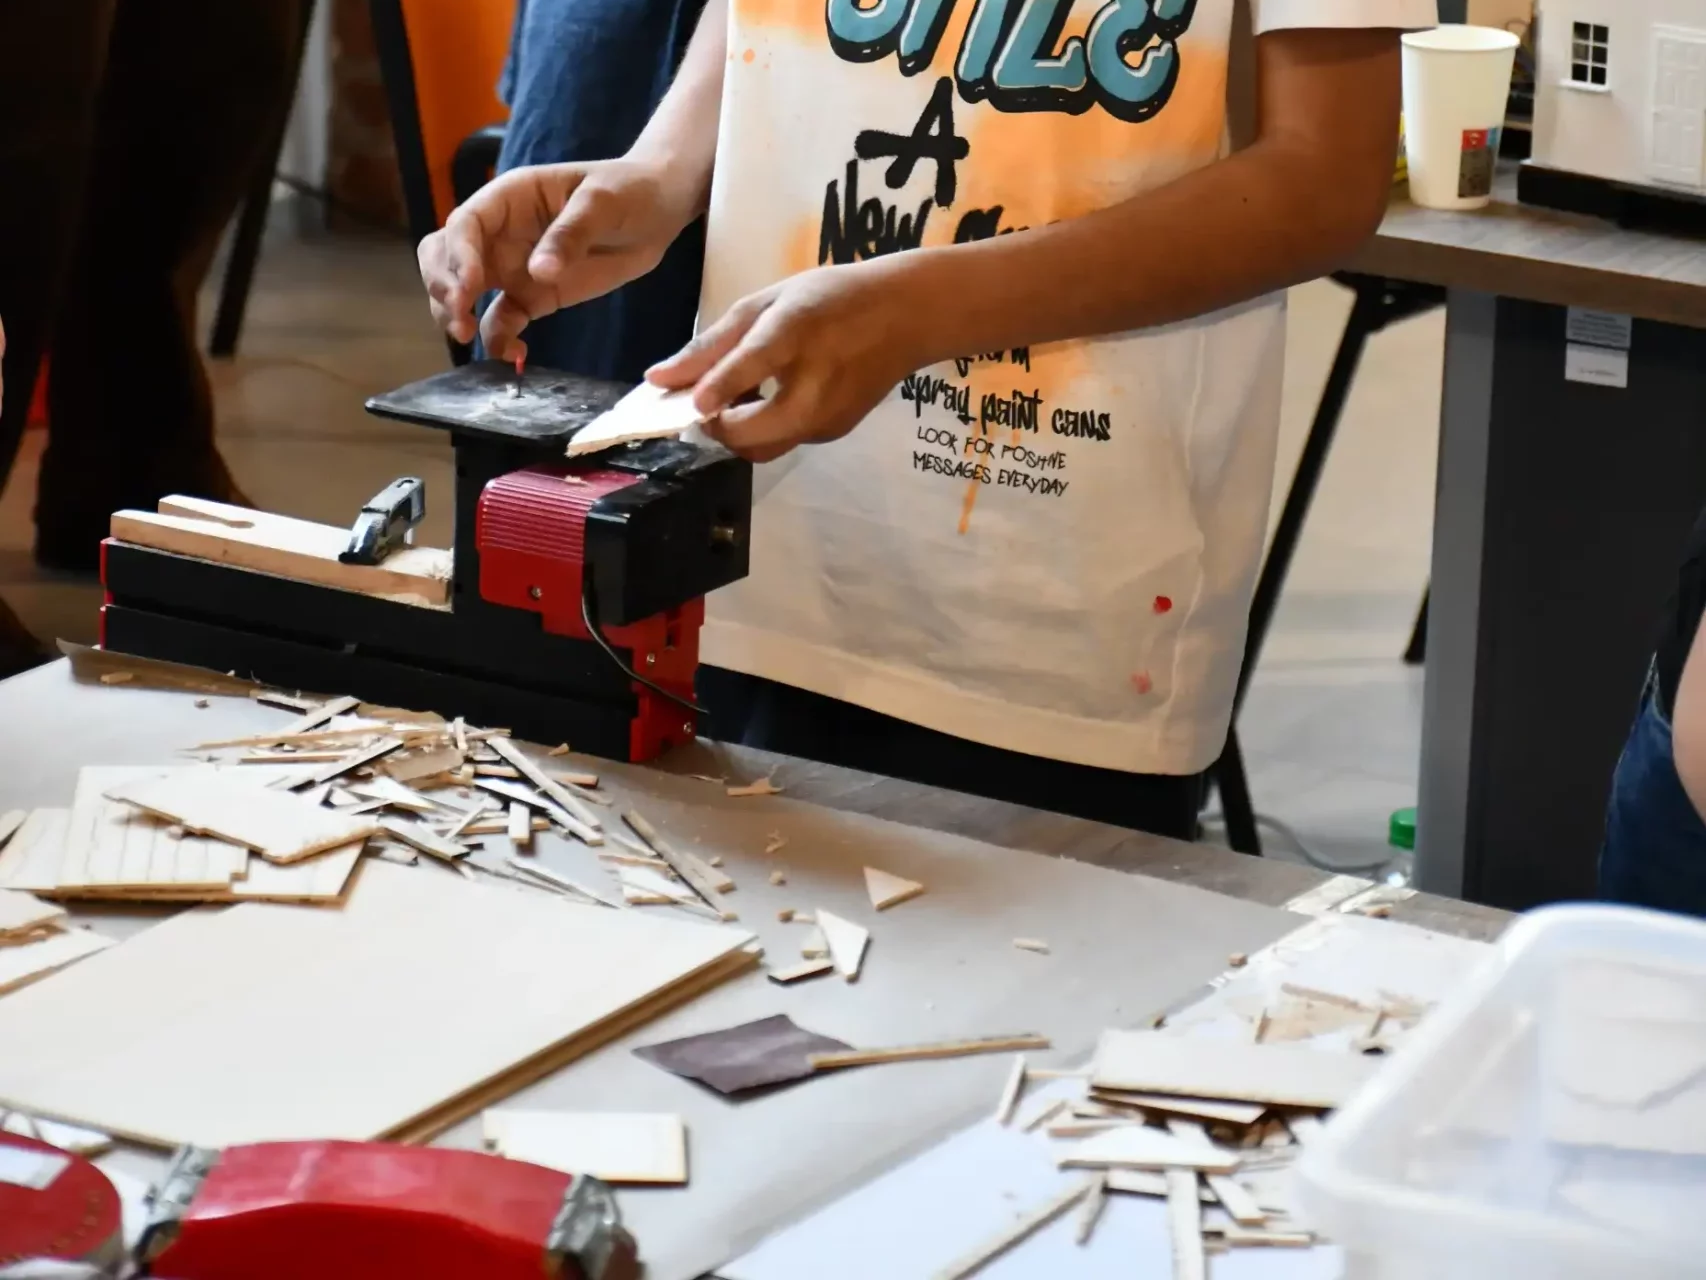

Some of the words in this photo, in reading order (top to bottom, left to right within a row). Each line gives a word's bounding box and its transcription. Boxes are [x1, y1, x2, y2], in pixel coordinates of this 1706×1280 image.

[854, 75, 970, 209] A
[818, 159, 936, 266] New
[901, 372, 977, 426] spray
[980, 388, 1043, 436] paint
[1051, 408, 1112, 442] cans
[912, 450, 992, 485] MESSAGES
[996, 468, 1070, 498] EVERYDAY
[917, 425, 958, 456] LOOK
[963, 436, 996, 460] FOR
[1000, 444, 1067, 472] POSITIVE
